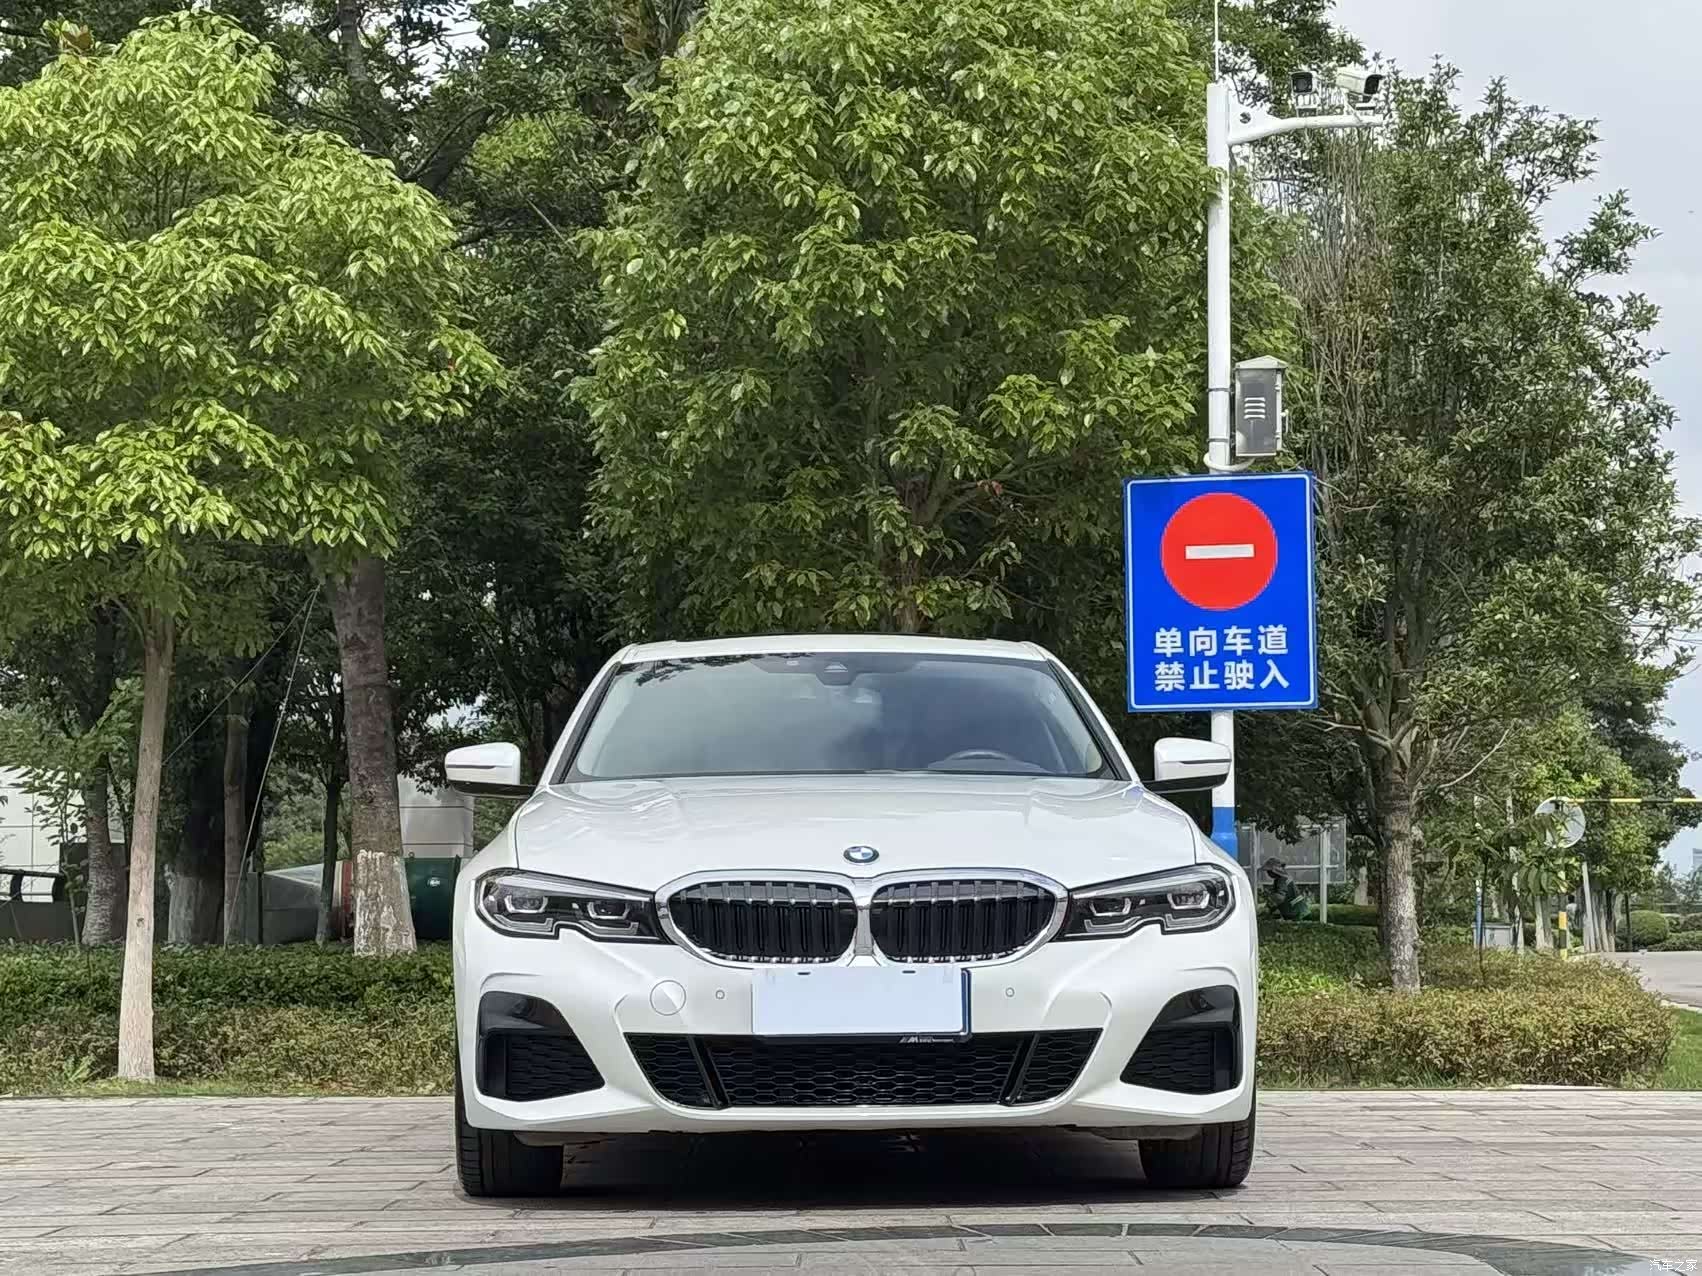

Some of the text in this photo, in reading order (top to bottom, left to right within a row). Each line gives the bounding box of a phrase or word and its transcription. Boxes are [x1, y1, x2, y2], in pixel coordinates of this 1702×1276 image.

[1154, 625, 1288, 657] 单向车道
[1155, 660, 1289, 692] 禁止驶入
